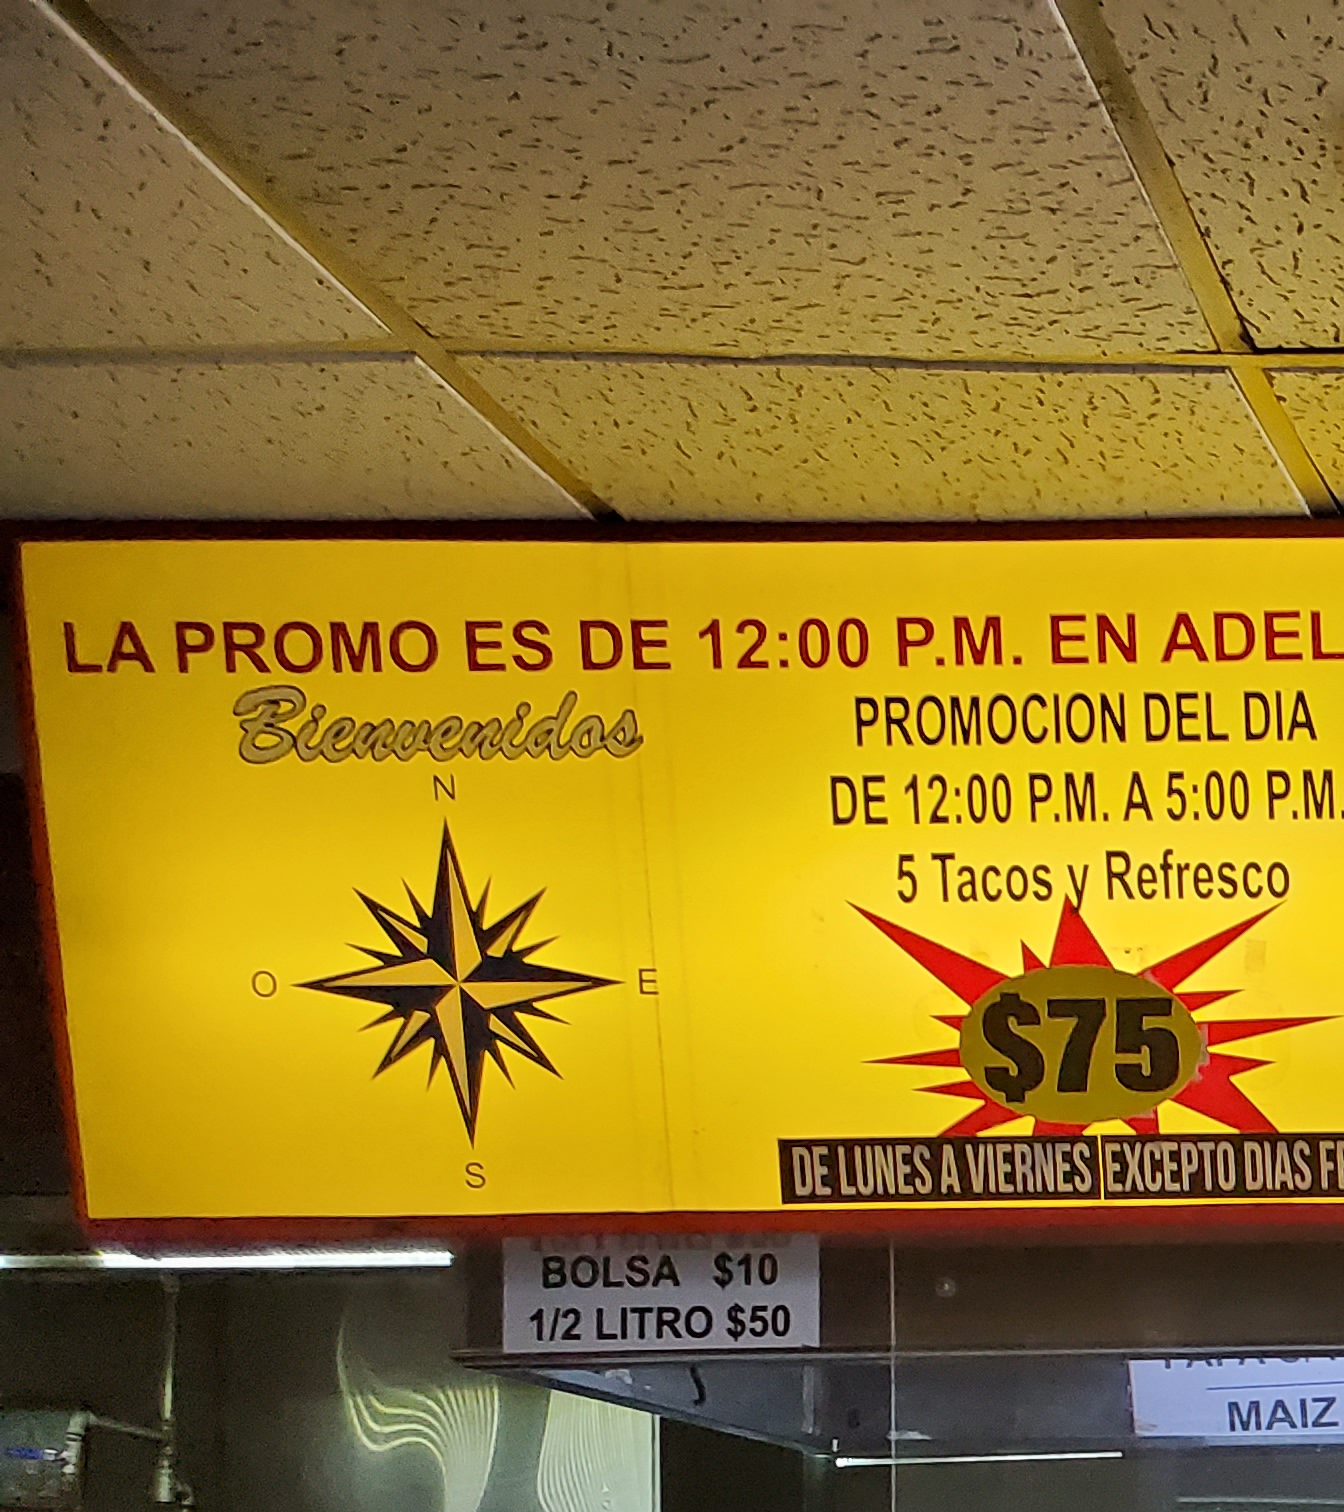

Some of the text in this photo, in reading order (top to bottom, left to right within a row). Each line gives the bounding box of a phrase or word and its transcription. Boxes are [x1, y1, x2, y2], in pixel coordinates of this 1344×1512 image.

[64, 622, 155, 673] LA
[175, 620, 438, 673] PROMO
[465, 620, 552, 671] ES
[580, 620, 671, 670] DE
[699, 618, 868, 669] 12:00
[897, 616, 1022, 666] P.M.
[1050, 614, 1136, 664] EN
[232, 684, 644, 764] Bienvenidos
[855, 691, 1317, 746] PROMOCION DEL DIA
[433, 775, 455, 800] N
[831, 775, 888, 825] DE
[905, 773, 1011, 824] 12:00
[1029, 772, 1108, 822] P.M.
[1124, 772, 1153, 821] A
[1167, 771, 1249, 821] 5:00
[898, 849, 1289, 914] 5 Tacos y Refresco
[252, 969, 658, 997] O E
[980, 991, 1181, 1104] $75
[466, 1163, 486, 1188] S
[792, 1147, 833, 1196] DE
[837, 1146, 932, 1194] LUNES
[940, 1146, 960, 1192] A
[964, 1142, 1093, 1193] VIERNES
[1105, 1143, 1238, 1192] EXCEPTO
[1243, 1141, 1313, 1191] DIAS
[541, 1251, 779, 1290] BOLSA $10
[530, 1303, 790, 1342] 1/2 LITRO $50
[1228, 1397, 1338, 1432] MAIZ
